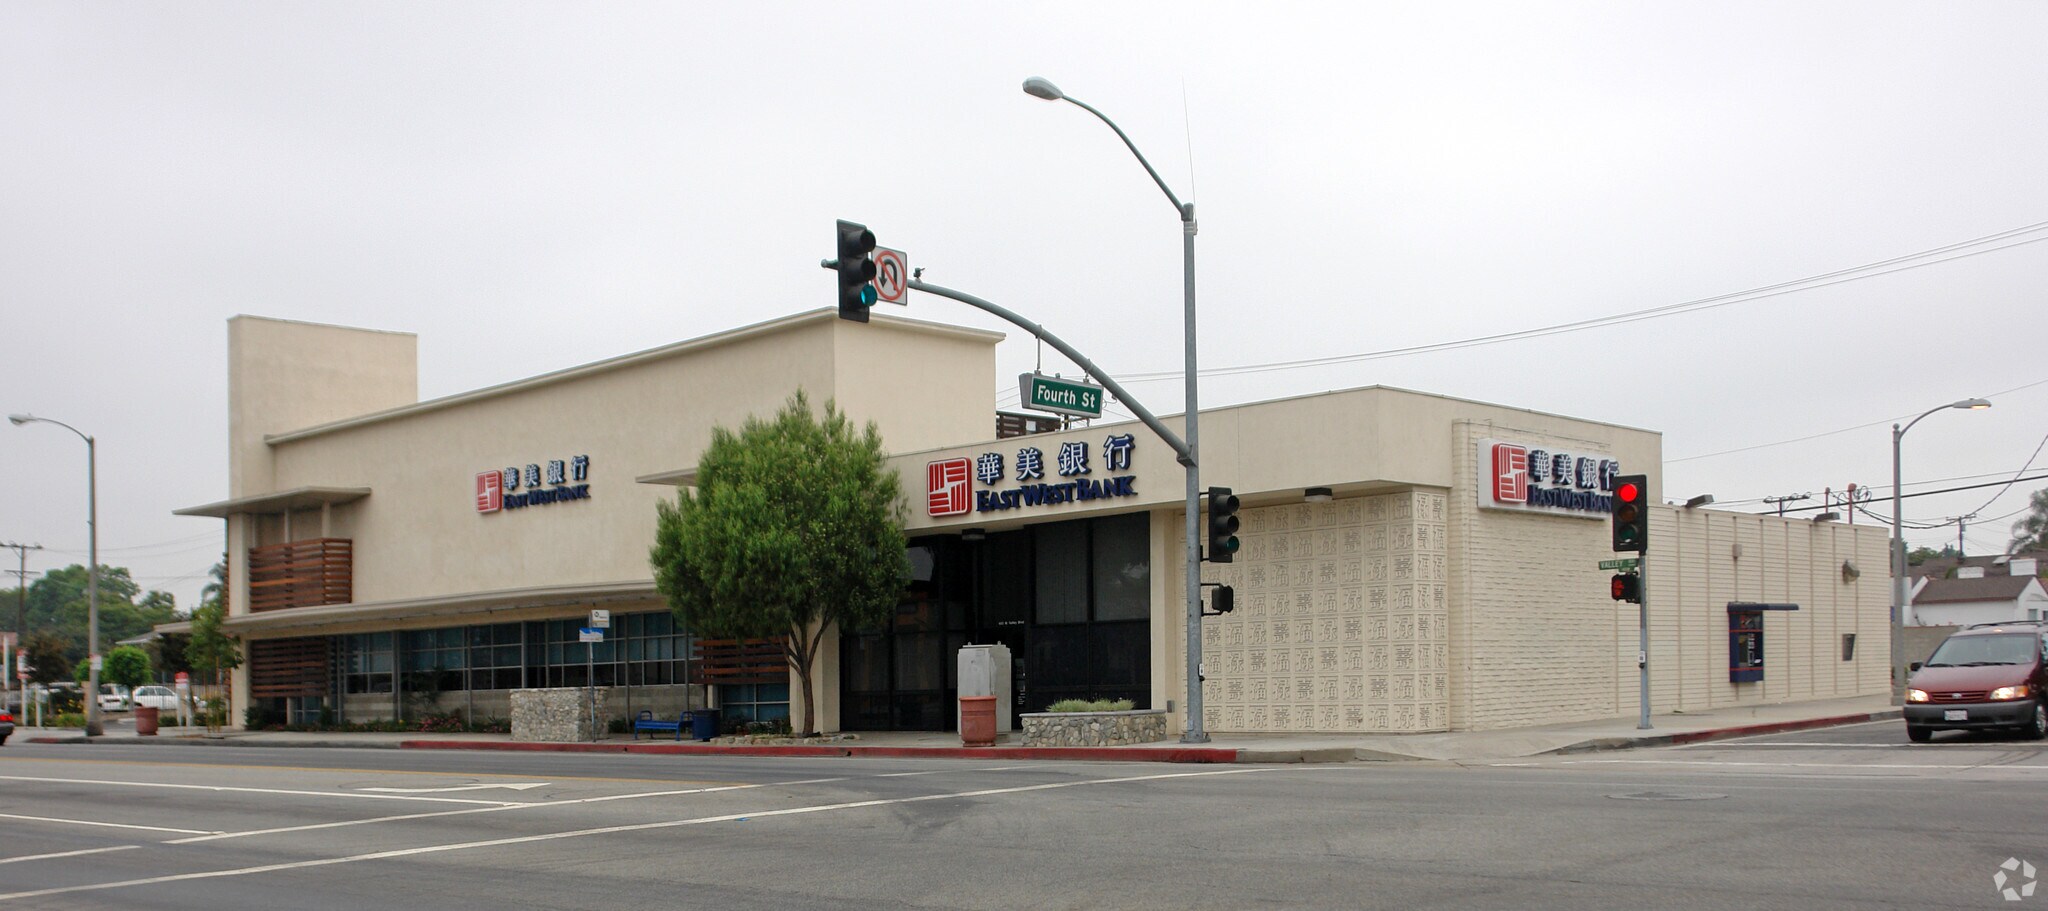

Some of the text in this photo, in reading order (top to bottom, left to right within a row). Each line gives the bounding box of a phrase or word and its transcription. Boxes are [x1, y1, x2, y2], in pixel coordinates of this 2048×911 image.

[1037, 385, 1096, 408] Fourth St
[504, 455, 589, 491] 華美銀行
[977, 433, 1135, 485] 華美銀行
[1600, 559, 1623, 568] VALLEY
